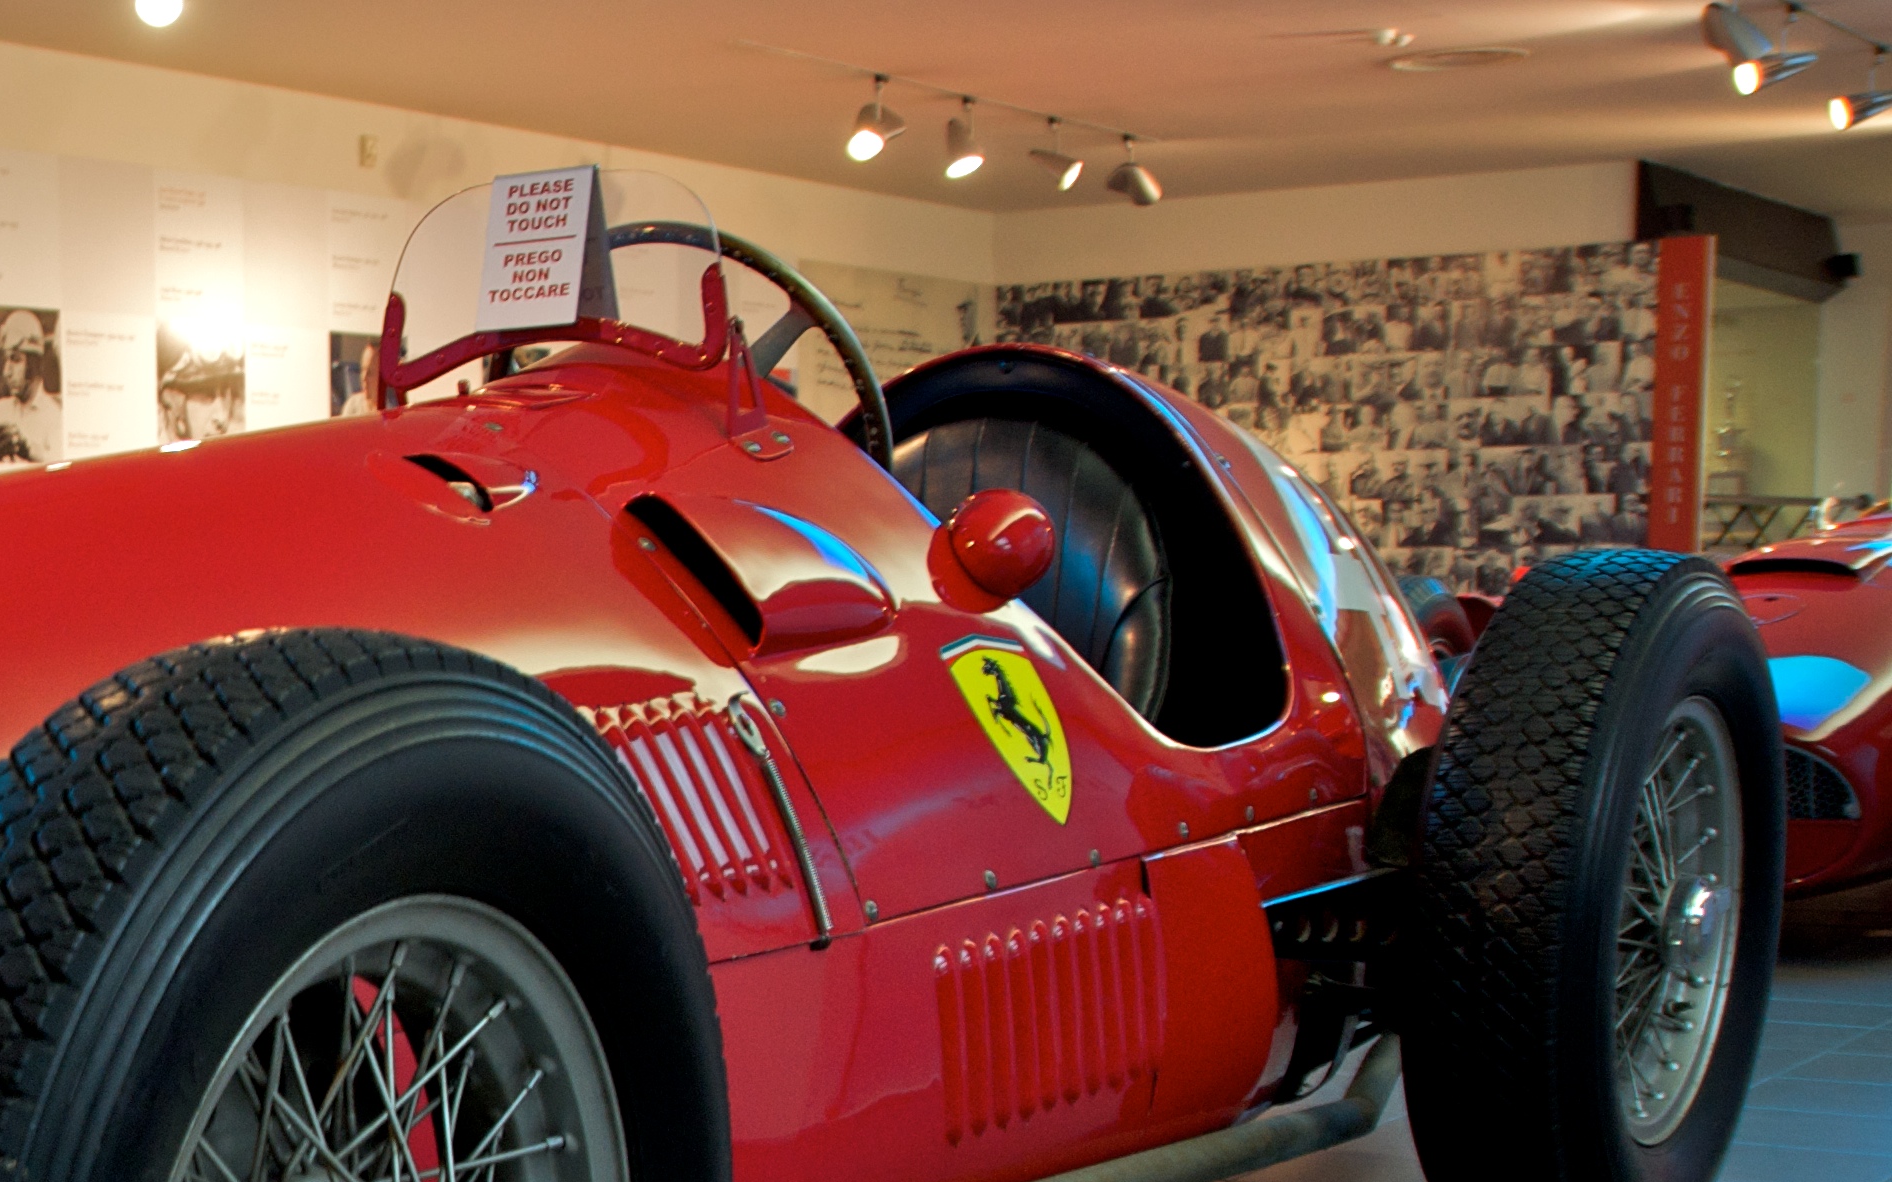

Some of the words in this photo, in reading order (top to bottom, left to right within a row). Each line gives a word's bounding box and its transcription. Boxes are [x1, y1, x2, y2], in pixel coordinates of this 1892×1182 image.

[508, 178, 575, 199] PLEASE
[506, 201, 530, 216] DO
[535, 196, 573, 213] NOT
[508, 214, 568, 233] TOUCH
[503, 249, 563, 268] PREGO
[512, 267, 550, 284] NON
[488, 283, 571, 303] TOCCARE
